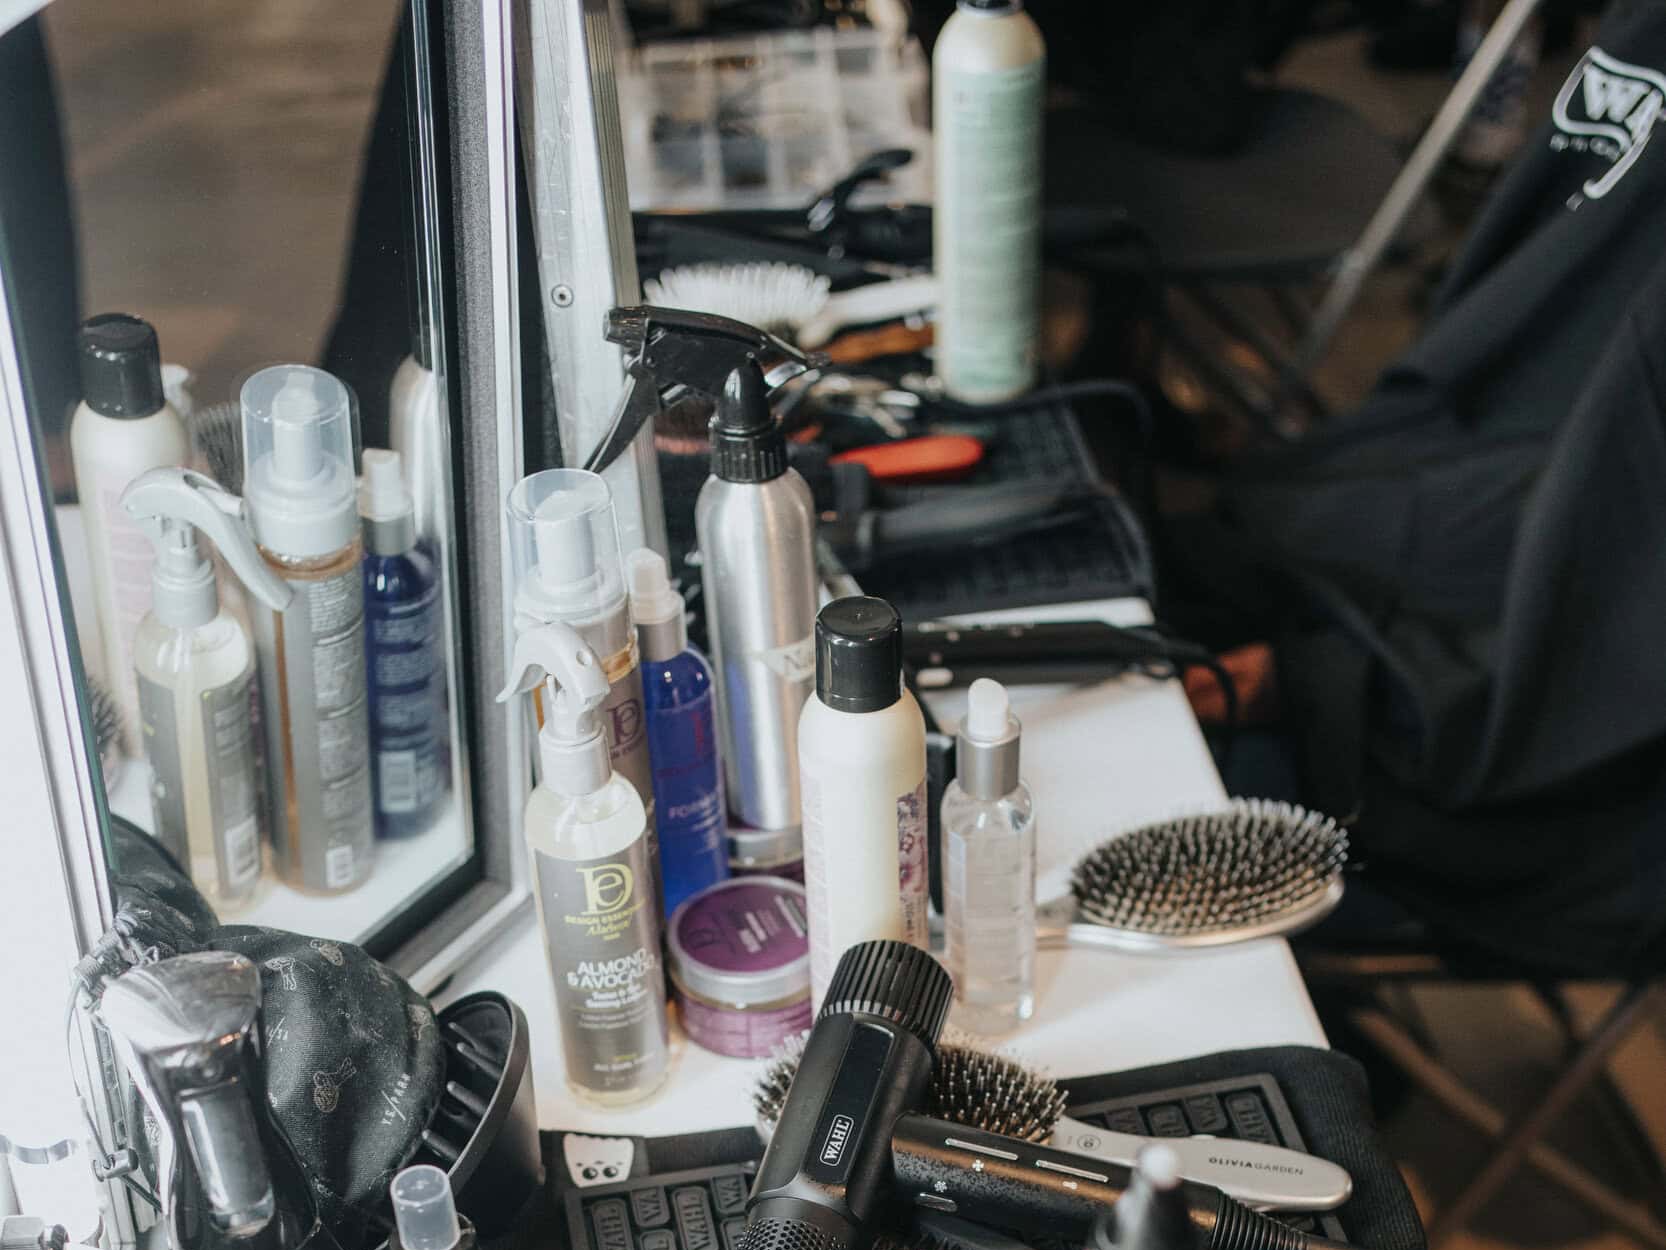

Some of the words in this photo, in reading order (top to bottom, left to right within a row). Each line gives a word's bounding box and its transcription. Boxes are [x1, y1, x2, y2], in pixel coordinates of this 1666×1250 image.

[577, 948, 646, 975] ALMOND
[824, 1119, 850, 1159] WAHL
[638, 1187, 663, 1222] WA
[719, 1176, 742, 1208] WA
[683, 1192, 711, 1250] WAHL
